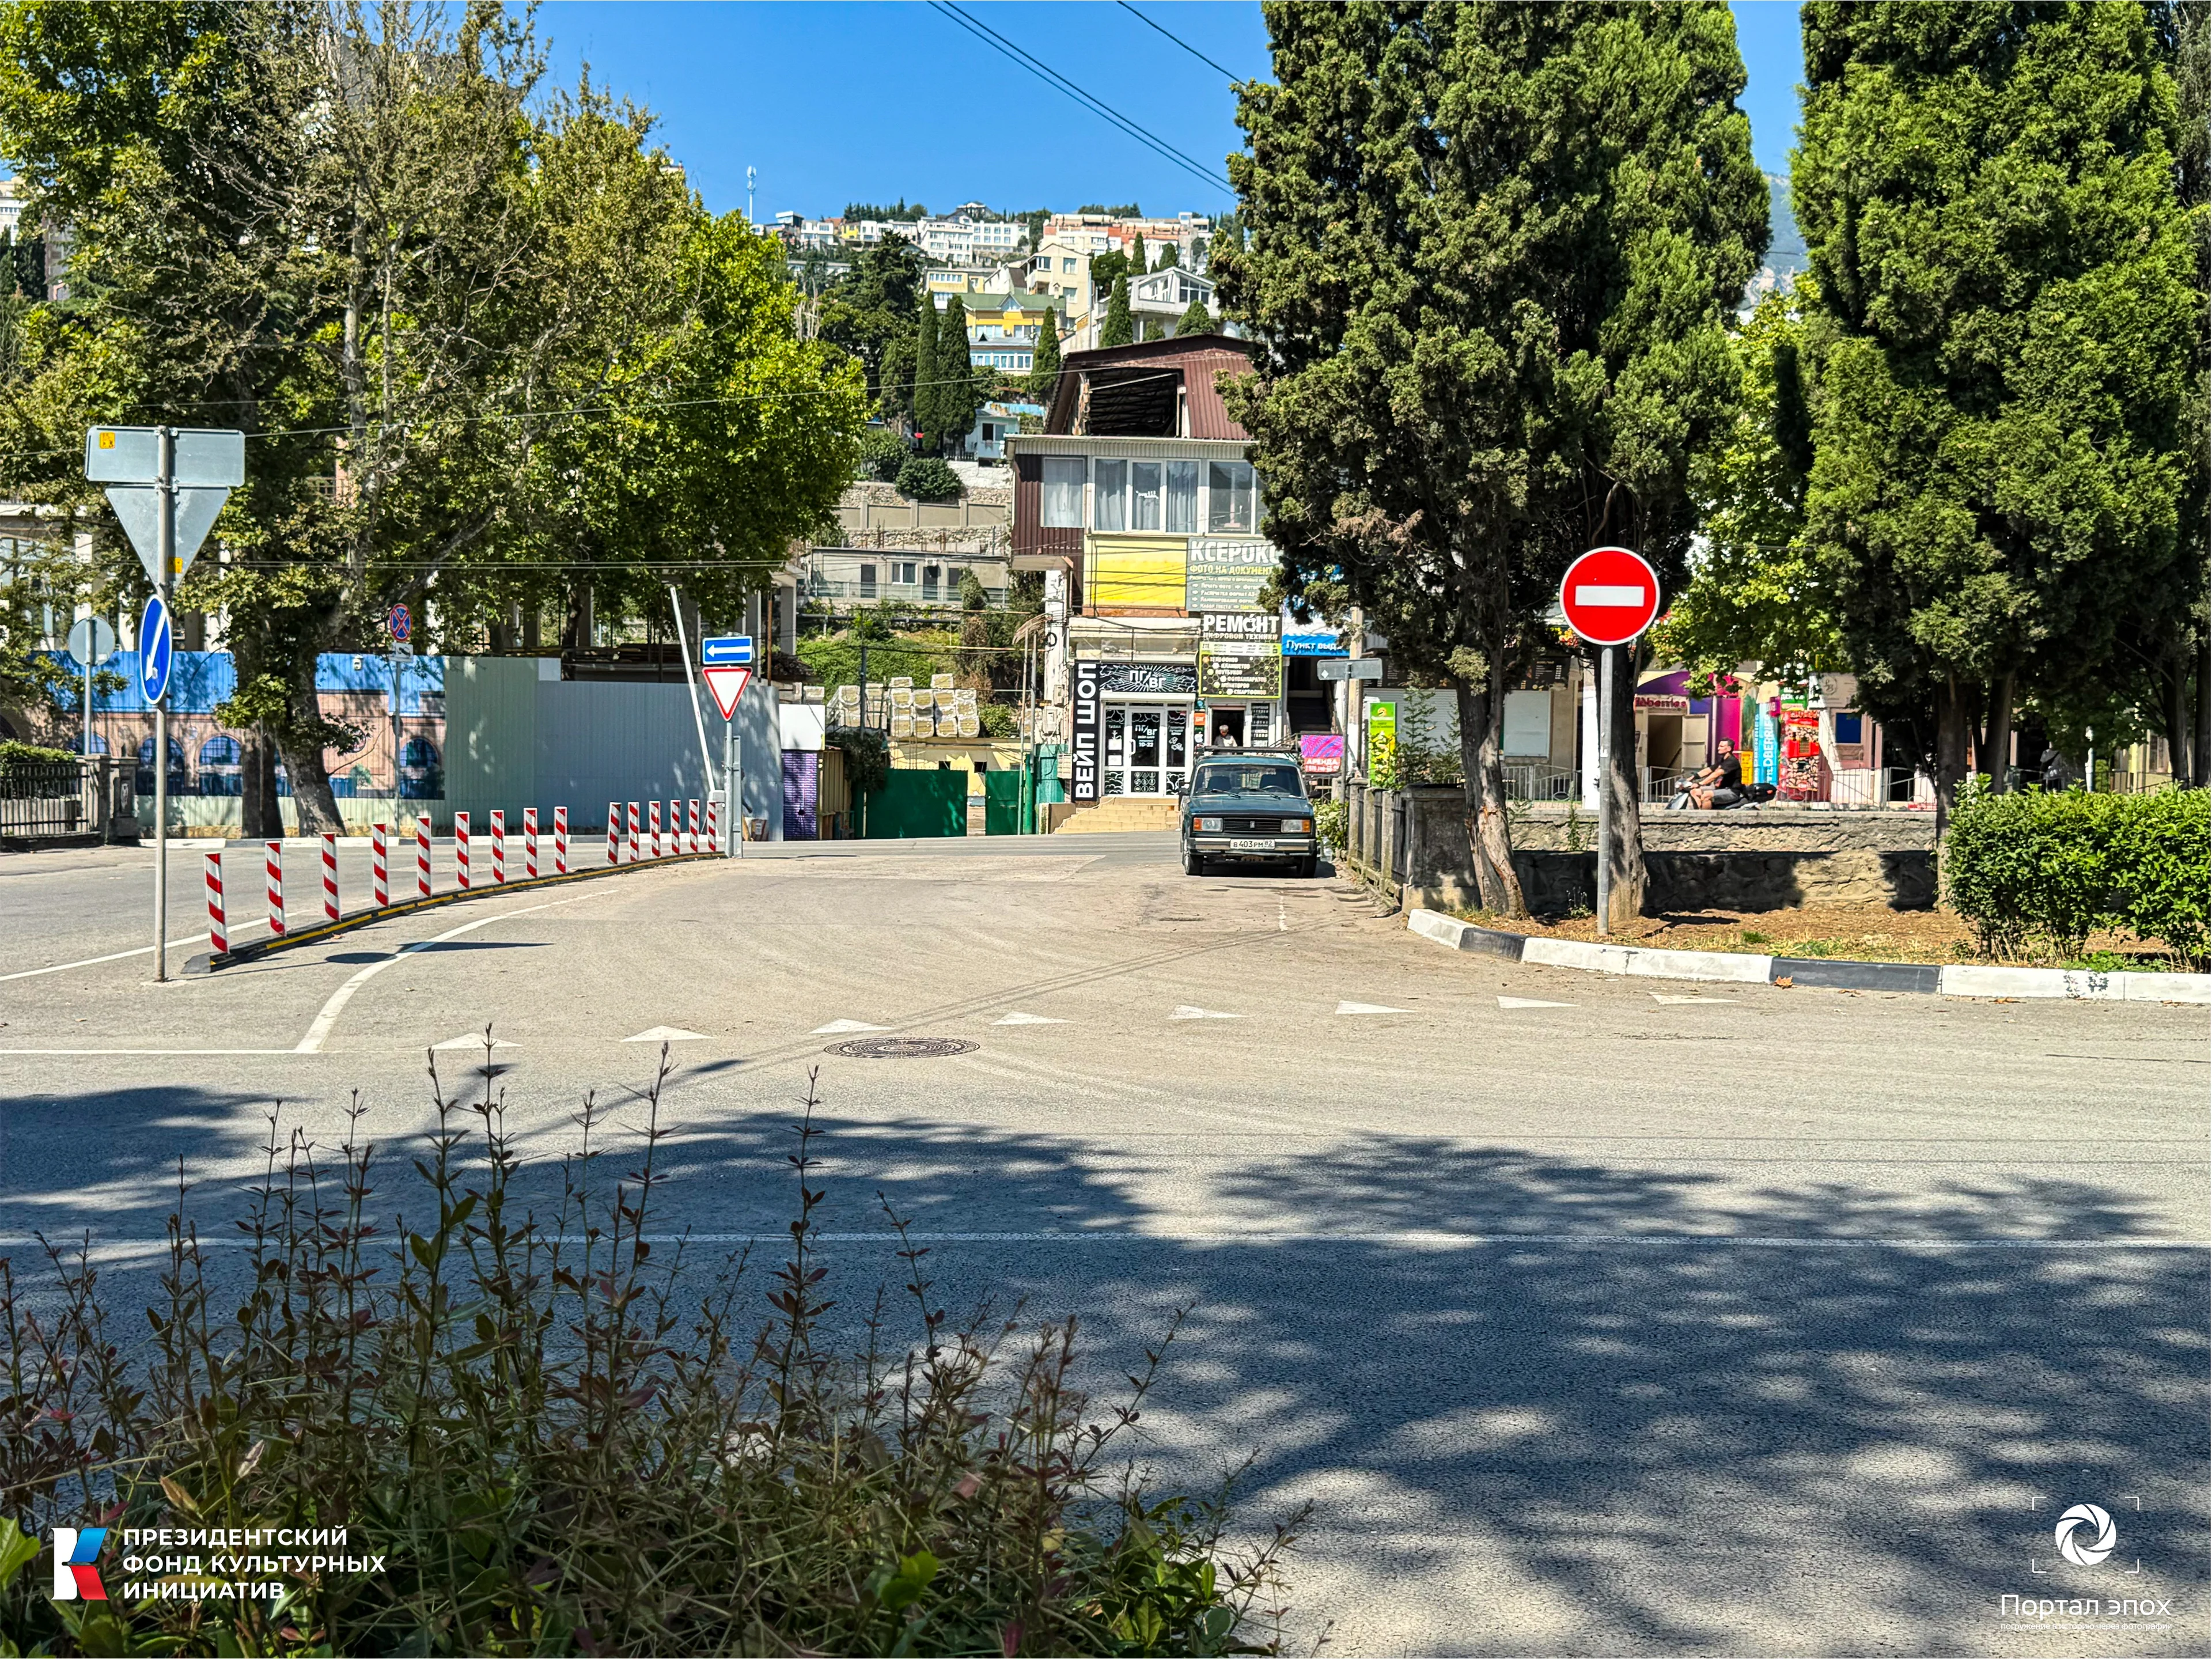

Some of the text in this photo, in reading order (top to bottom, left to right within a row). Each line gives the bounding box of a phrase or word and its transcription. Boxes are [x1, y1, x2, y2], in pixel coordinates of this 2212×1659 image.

[1191, 541, 1279, 563] КСЕРОКС
[1190, 565, 1273, 575] ФОТО НА ДОКУМЕНТ
[1203, 614, 1279, 633] РЕМОНТ
[1286, 640, 1316, 651] Пункт
[1130, 671, 1166, 689] ПГ/ВГ
[1073, 663, 1096, 798] ВЕЙП ШОП
